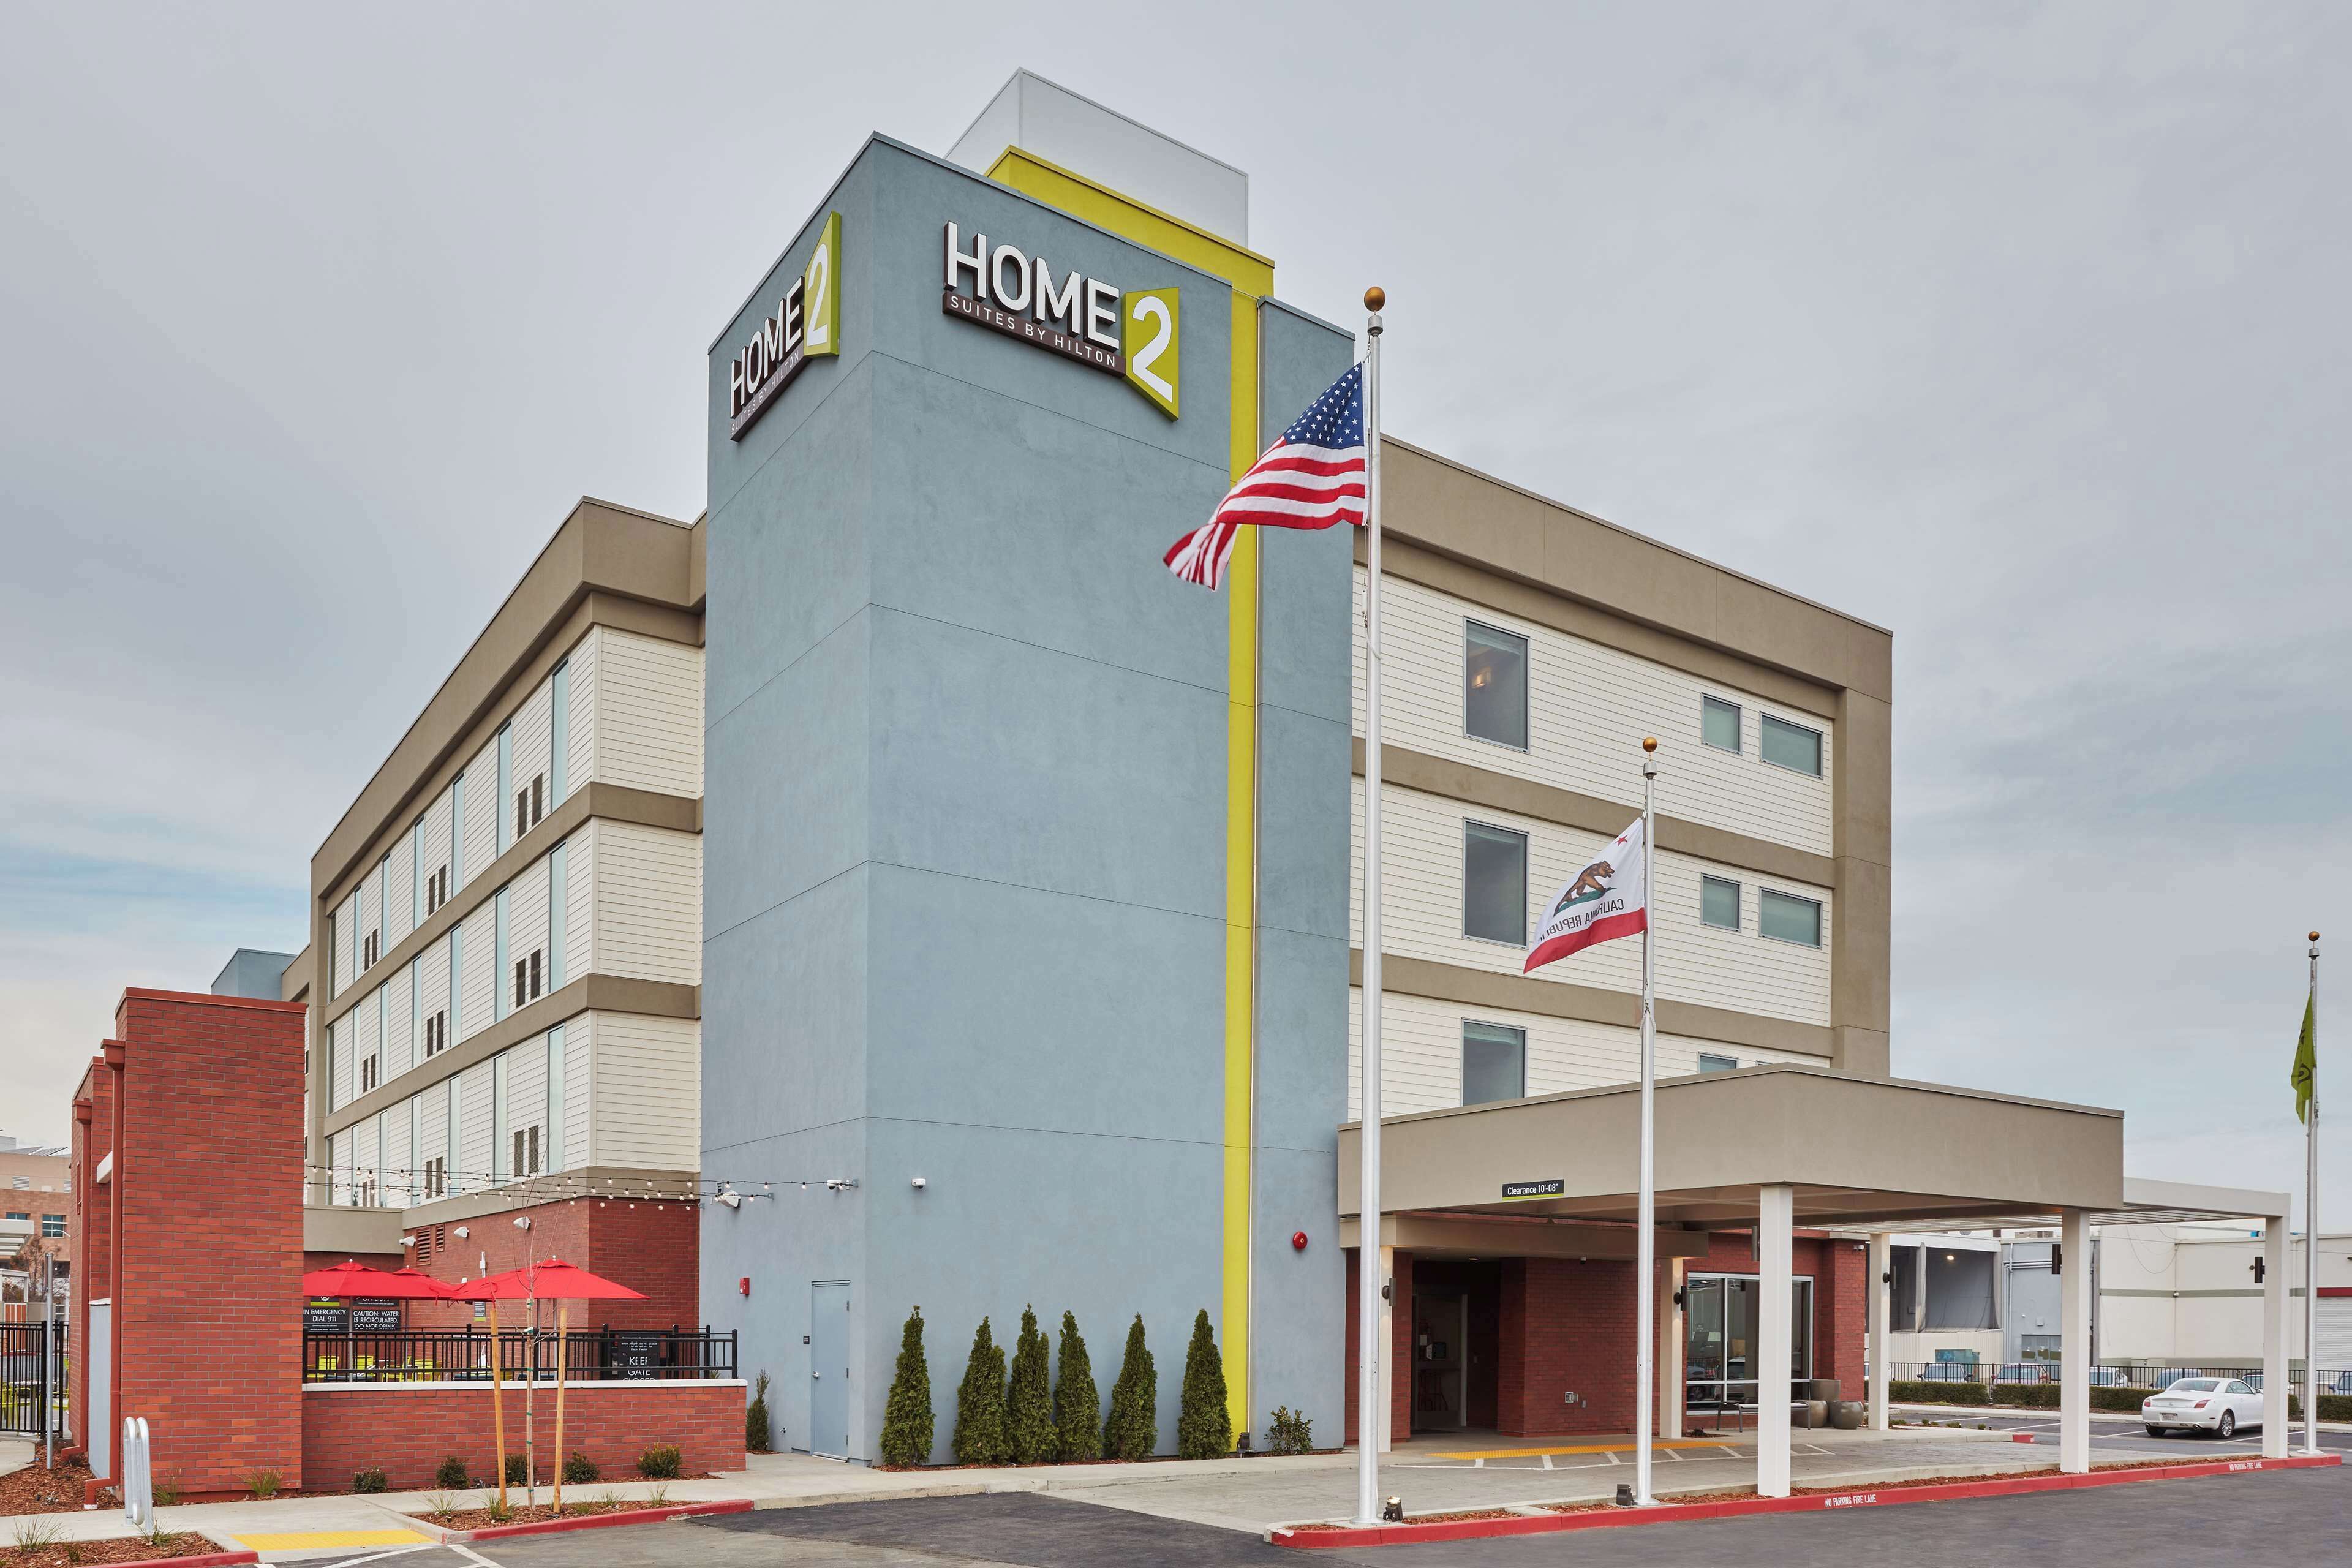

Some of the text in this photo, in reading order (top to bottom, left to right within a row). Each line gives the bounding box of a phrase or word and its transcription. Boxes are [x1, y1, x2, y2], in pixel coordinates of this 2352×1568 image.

[730, 276, 802, 418] HOME
[948, 221, 1172, 403] HOME 2
[951, 295, 1115, 368] SUITES BY HILTON
[731, 350, 799, 435] SUITES BY HILTON
[1507, 1183, 1558, 1195] Clearance 10'-08"
[1825, 1494, 1877, 1507] NO PARKING FIRE LANE
